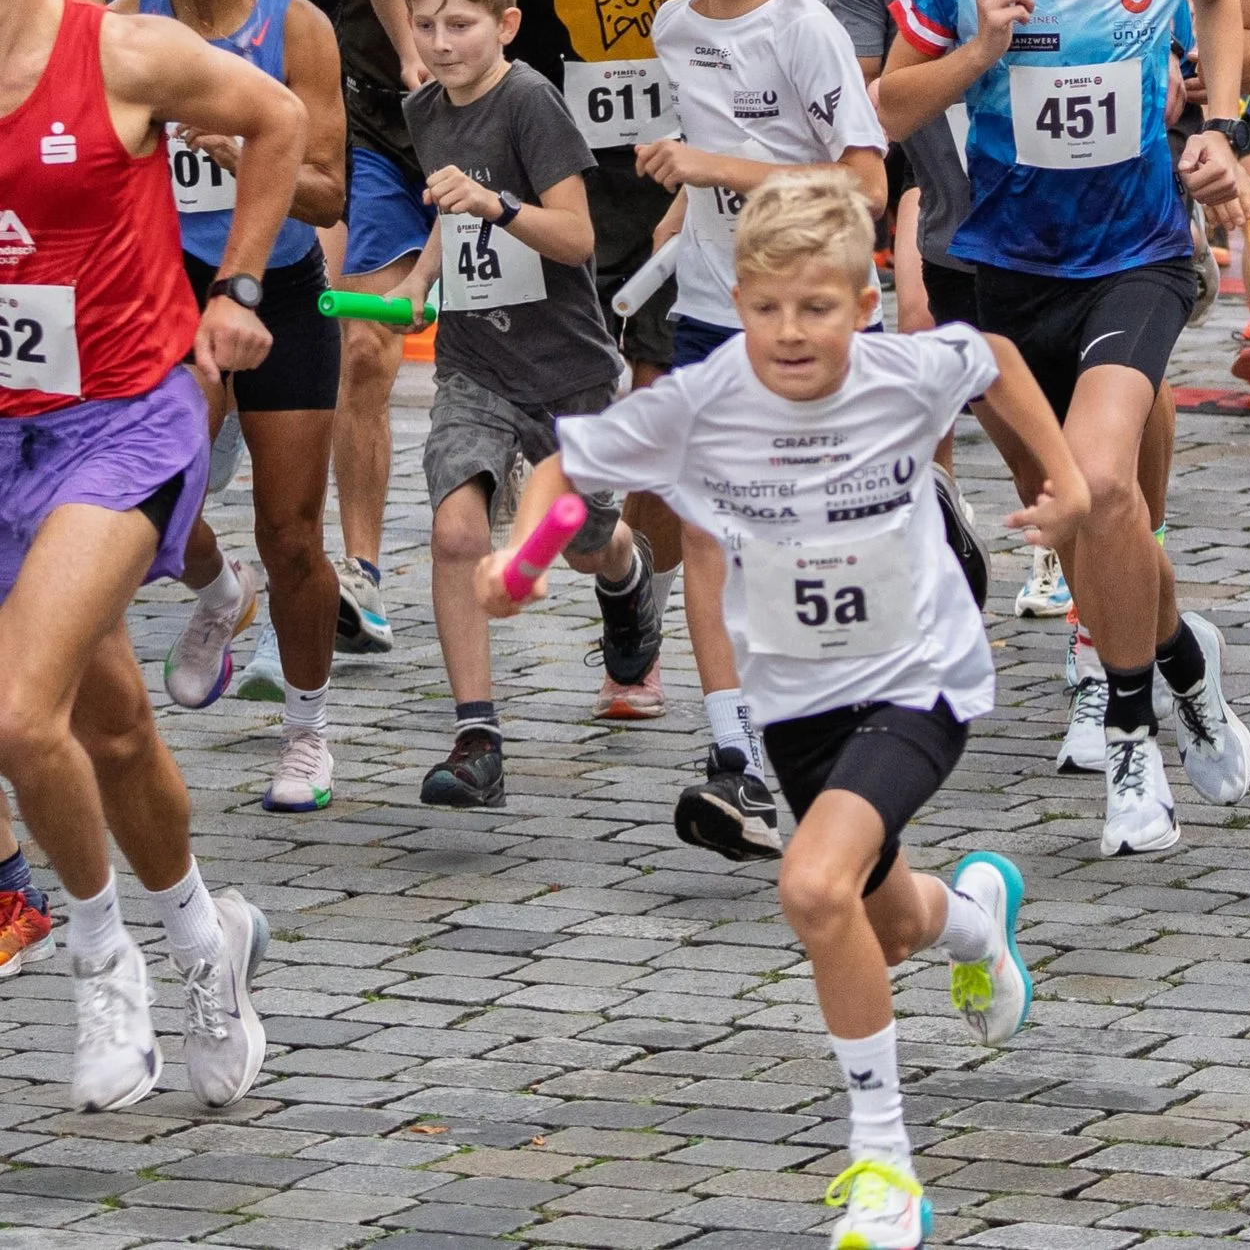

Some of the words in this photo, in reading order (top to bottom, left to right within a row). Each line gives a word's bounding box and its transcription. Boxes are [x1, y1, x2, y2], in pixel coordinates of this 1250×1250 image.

[695, 46, 722, 57] CRAFT
[1064, 77, 1092, 85] PEMSEL
[587, 82, 661, 124] 611
[1036, 91, 1117, 139] 451
[167, 150, 223, 188] 01
[458, 241, 503, 282] 4a
[772, 435, 830, 449] CRAFT
[794, 578, 869, 627] 5a
